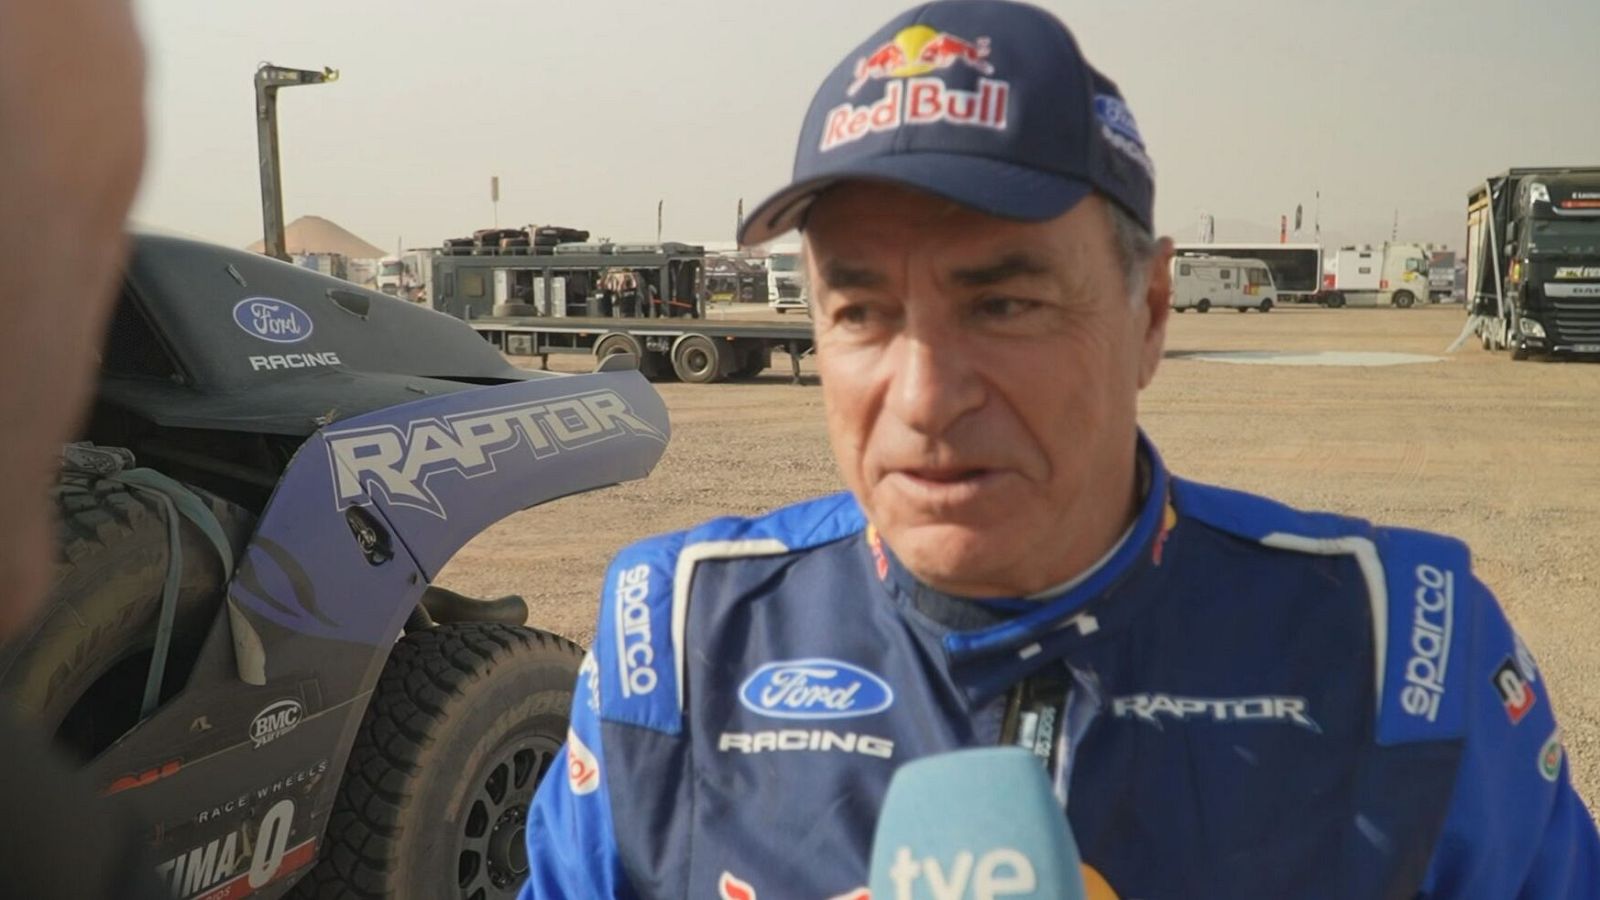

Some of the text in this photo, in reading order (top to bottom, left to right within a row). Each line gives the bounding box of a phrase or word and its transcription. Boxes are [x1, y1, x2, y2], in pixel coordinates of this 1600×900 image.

[819, 77, 1010, 153] Red Bull
[251, 299, 302, 336] Ford
[249, 351, 341, 372] RACING
[323, 390, 669, 518] RAPTOR
[616, 563, 658, 698] sparco
[1400, 564, 1452, 722] sparco
[758, 664, 862, 711] Ford
[255, 706, 298, 735] BMC
[1113, 693, 1323, 734] RAPTOR
[718, 729, 895, 758] RACING
[197, 762, 328, 824] RACE WHEELS
[889, 844, 1037, 900] tve
